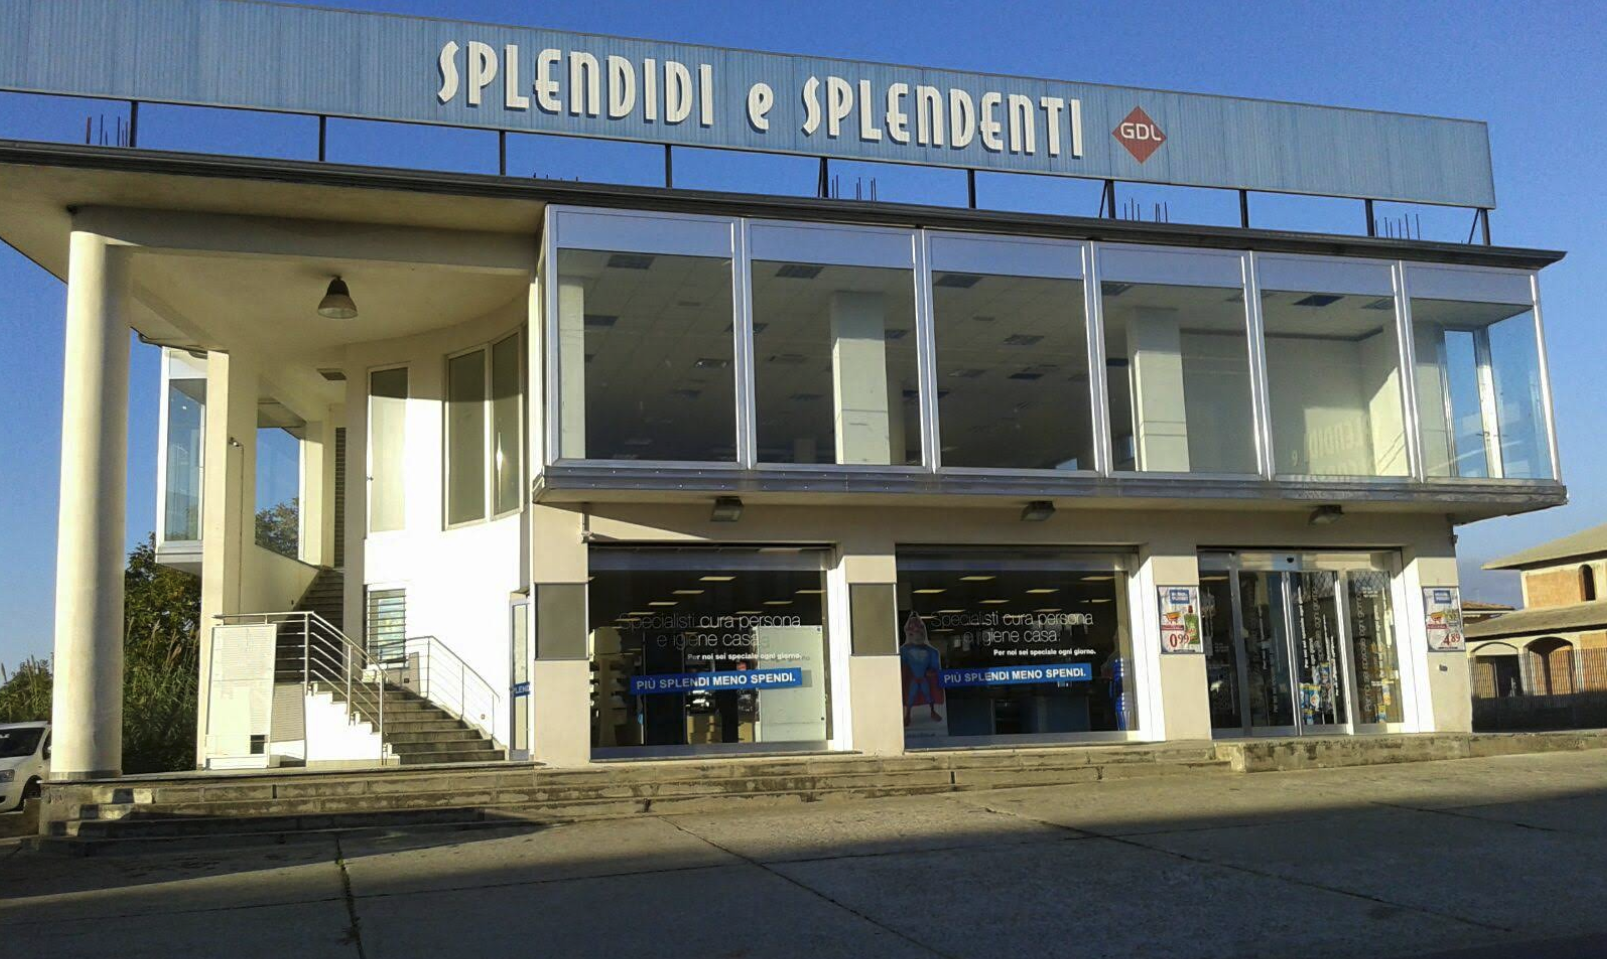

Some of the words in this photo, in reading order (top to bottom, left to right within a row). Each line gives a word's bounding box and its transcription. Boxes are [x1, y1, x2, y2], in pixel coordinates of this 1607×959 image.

[436, 40, 714, 127] SPLENDIDI
[747, 82, 773, 132] e
[802, 75, 1084, 159] SPLENDENTI
[1120, 122, 1162, 142] GDL
[699, 615, 736, 629] cura
[738, 615, 802, 632] persona
[930, 610, 999, 629] Specialisti
[1002, 613, 1034, 627] cura
[1038, 612, 1094, 630] persona
[656, 635, 667, 646] e
[672, 632, 718, 650] igiene
[963, 630, 973, 642] e
[976, 628, 1020, 646] igiene
[687, 654, 700, 662] Per
[702, 653, 714, 661] noi
[714, 653, 726, 661] sei
[728, 653, 759, 663] speciale
[993, 648, 1005, 656] Per
[1030, 648, 1057, 658] speciale
[1058, 648, 1072, 658] ogni
[1074, 648, 1096, 657] giorno.
[636, 676, 656, 690] PIÙ
[659, 674, 710, 689] SPLENDI
[712, 674, 748, 688] MENO
[750, 672, 797, 686] SPENDI.
[944, 670, 962, 684] PIÙ
[964, 669, 1010, 682] SPLENDI
[1012, 668, 1043, 681] MENO
[1046, 667, 1086, 680] SPENDI.
